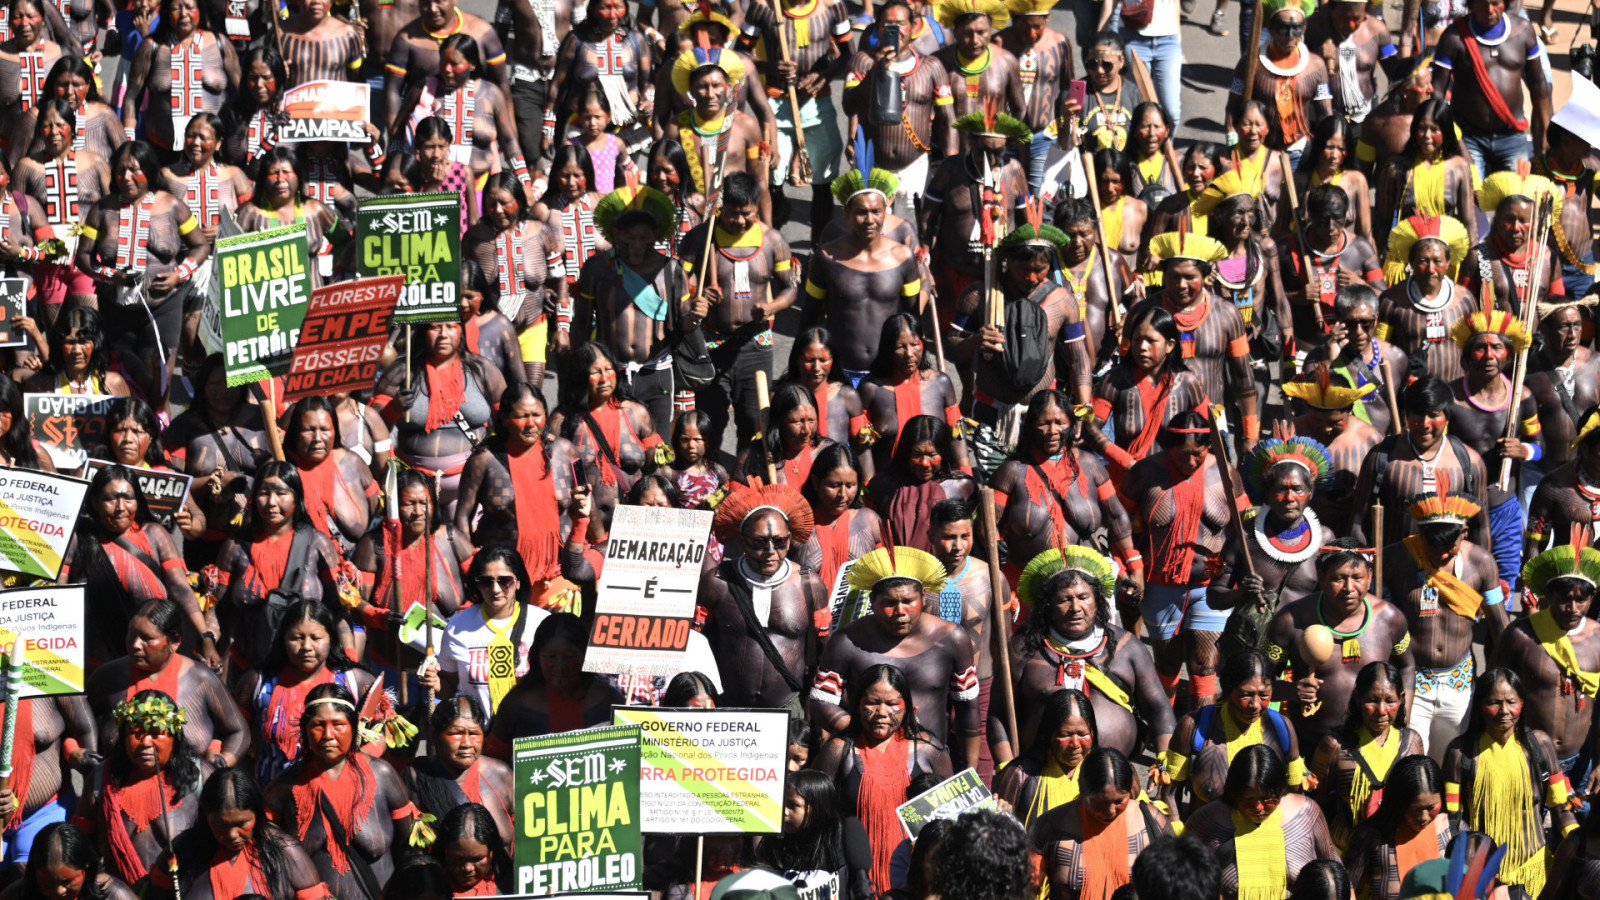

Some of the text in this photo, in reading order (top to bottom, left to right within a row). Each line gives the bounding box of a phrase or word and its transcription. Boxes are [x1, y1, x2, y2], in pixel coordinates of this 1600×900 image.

[283, 118, 365, 138] PAMPAS
[382, 210, 432, 234] SEM
[364, 231, 452, 268] CLIMA
[222, 243, 305, 288] BRASIL
[224, 273, 307, 318] LIVRE
[310, 284, 397, 310] FLORESTA
[396, 280, 456, 306] RÓLEO
[257, 312, 280, 332] DE
[300, 305, 392, 344] EM PÉ
[226, 328, 300, 366] PETRÓLE
[291, 345, 381, 373] FÓSSEIS
[286, 372, 316, 392] NO
[3, 492, 54, 506] DA JUSTIÇA
[10, 479, 60, 495] FEDERAL
[11, 503, 32, 512] Povos
[608, 539, 704, 569] DEMARCAÇÃO
[643, 576, 658, 599] É
[2, 598, 58, 611] FEDERAL
[15, 612, 55, 622] JUSTIÇA
[12, 625, 36, 633] Povos
[592, 615, 690, 650] CERRADO
[641, 720, 761, 732] GOVERNO FEDERAL
[642, 736, 758, 748] MINISTÉRIO DA JUSTIÇA
[660, 750, 696, 759] Nacional
[698, 751, 712, 759] dos
[714, 751, 738, 759] Povos
[546, 752, 608, 789] SEM
[640, 767, 778, 782] RRA PROTEGIDA
[924, 776, 970, 808] FAUNA
[523, 781, 631, 838] CLIMA
[540, 828, 617, 863] PARA
[518, 851, 635, 896] PETRÓLEO
